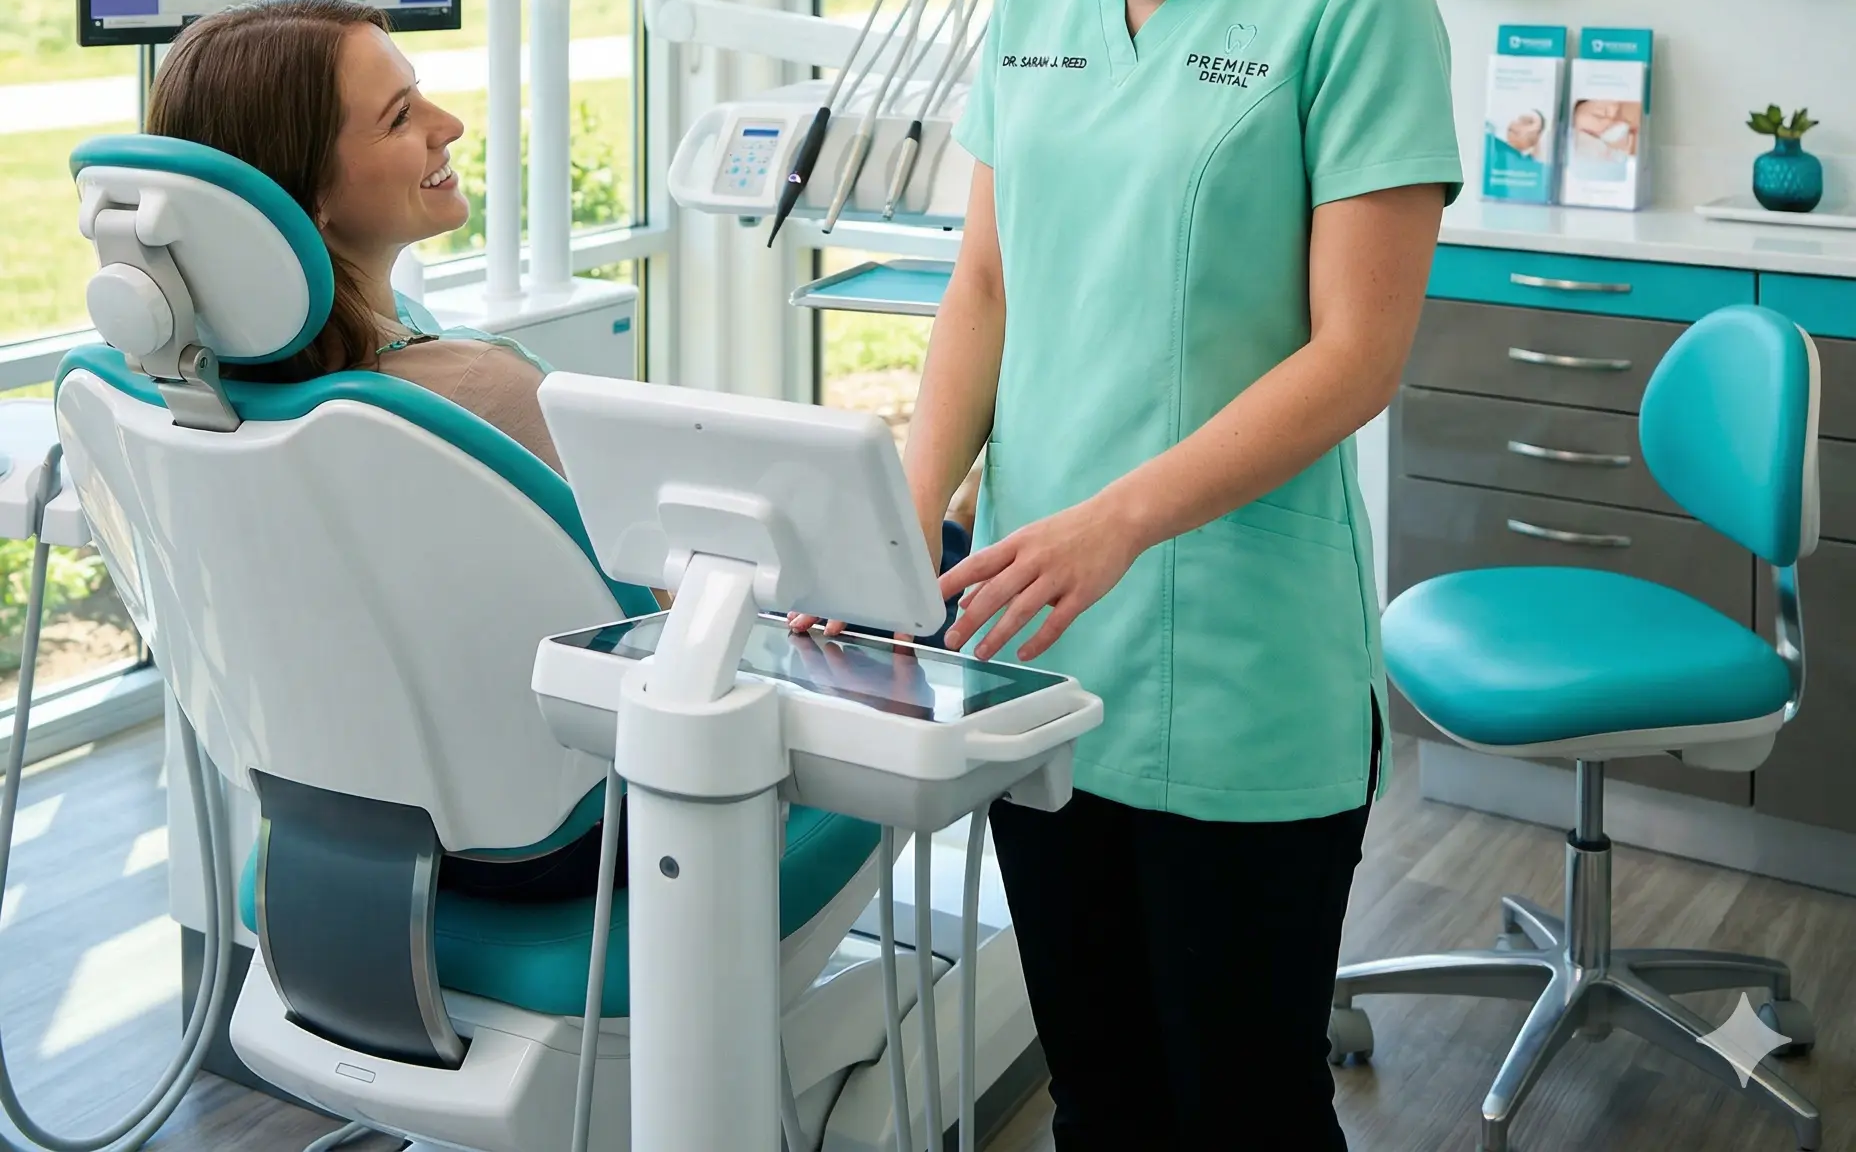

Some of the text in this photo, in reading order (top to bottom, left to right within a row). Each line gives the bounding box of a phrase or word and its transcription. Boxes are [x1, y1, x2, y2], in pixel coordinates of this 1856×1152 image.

[1002, 55, 1018, 67] DR.
[1062, 56, 1087, 69] REED
[1186, 53, 1269, 78] PREMIER
[1199, 70, 1248, 88] DENTAL
